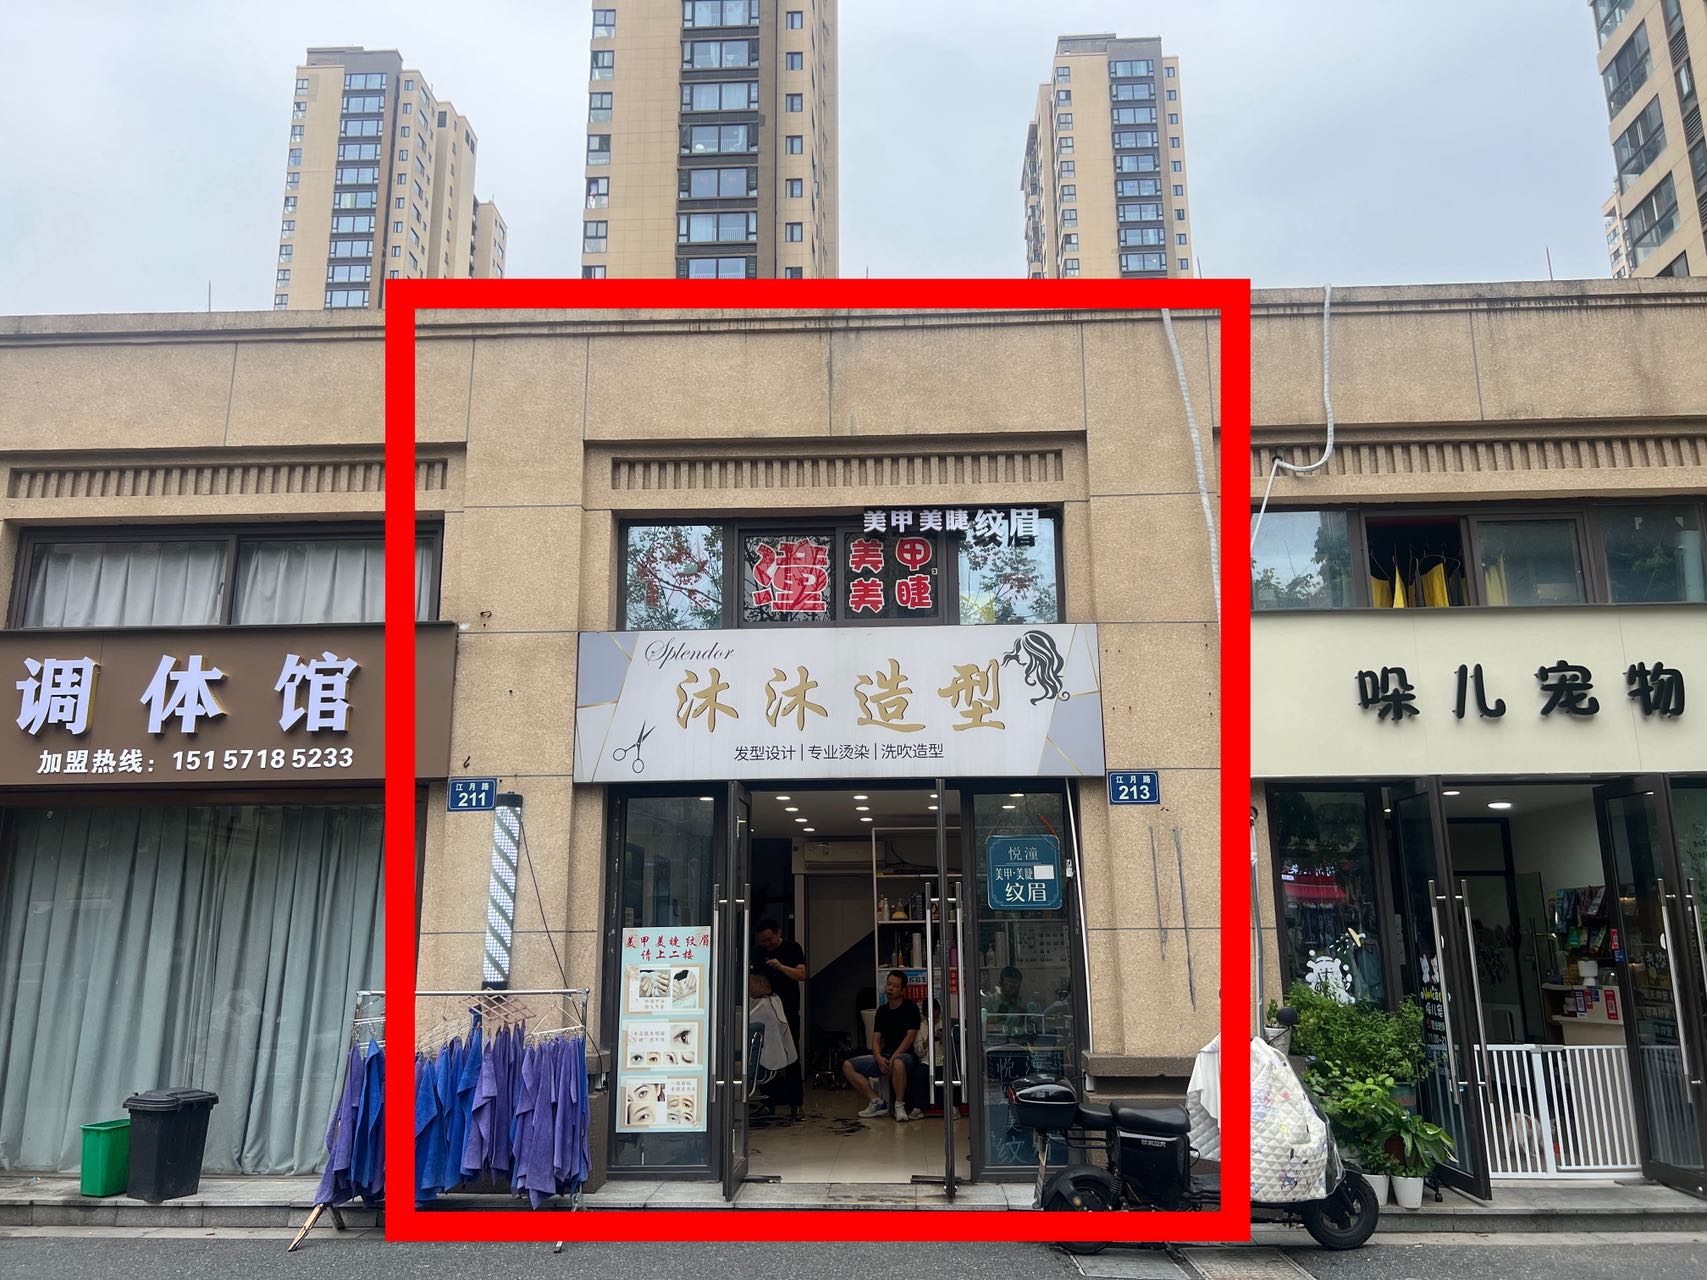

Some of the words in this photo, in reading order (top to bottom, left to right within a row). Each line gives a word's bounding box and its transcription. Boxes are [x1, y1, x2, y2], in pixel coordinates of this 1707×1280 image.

[645, 637, 735, 669] Splendor
[16, 651, 360, 735] 调体馆
[676, 658, 1006, 733] 沐沐造型
[1357, 660, 1685, 720] 哚儿宠物
[173, 750, 215, 771] 151
[223, 749, 285, 770] 5718
[291, 747, 354, 768] 5233
[734, 745, 796, 761] 发型设计
[807, 744, 870, 760] 专业烫染
[881, 743, 944, 760] 洗吹造型
[458, 792, 486, 807] 211
[1118, 785, 1150, 800] 213
[1005, 882, 1046, 902] 纹眉
